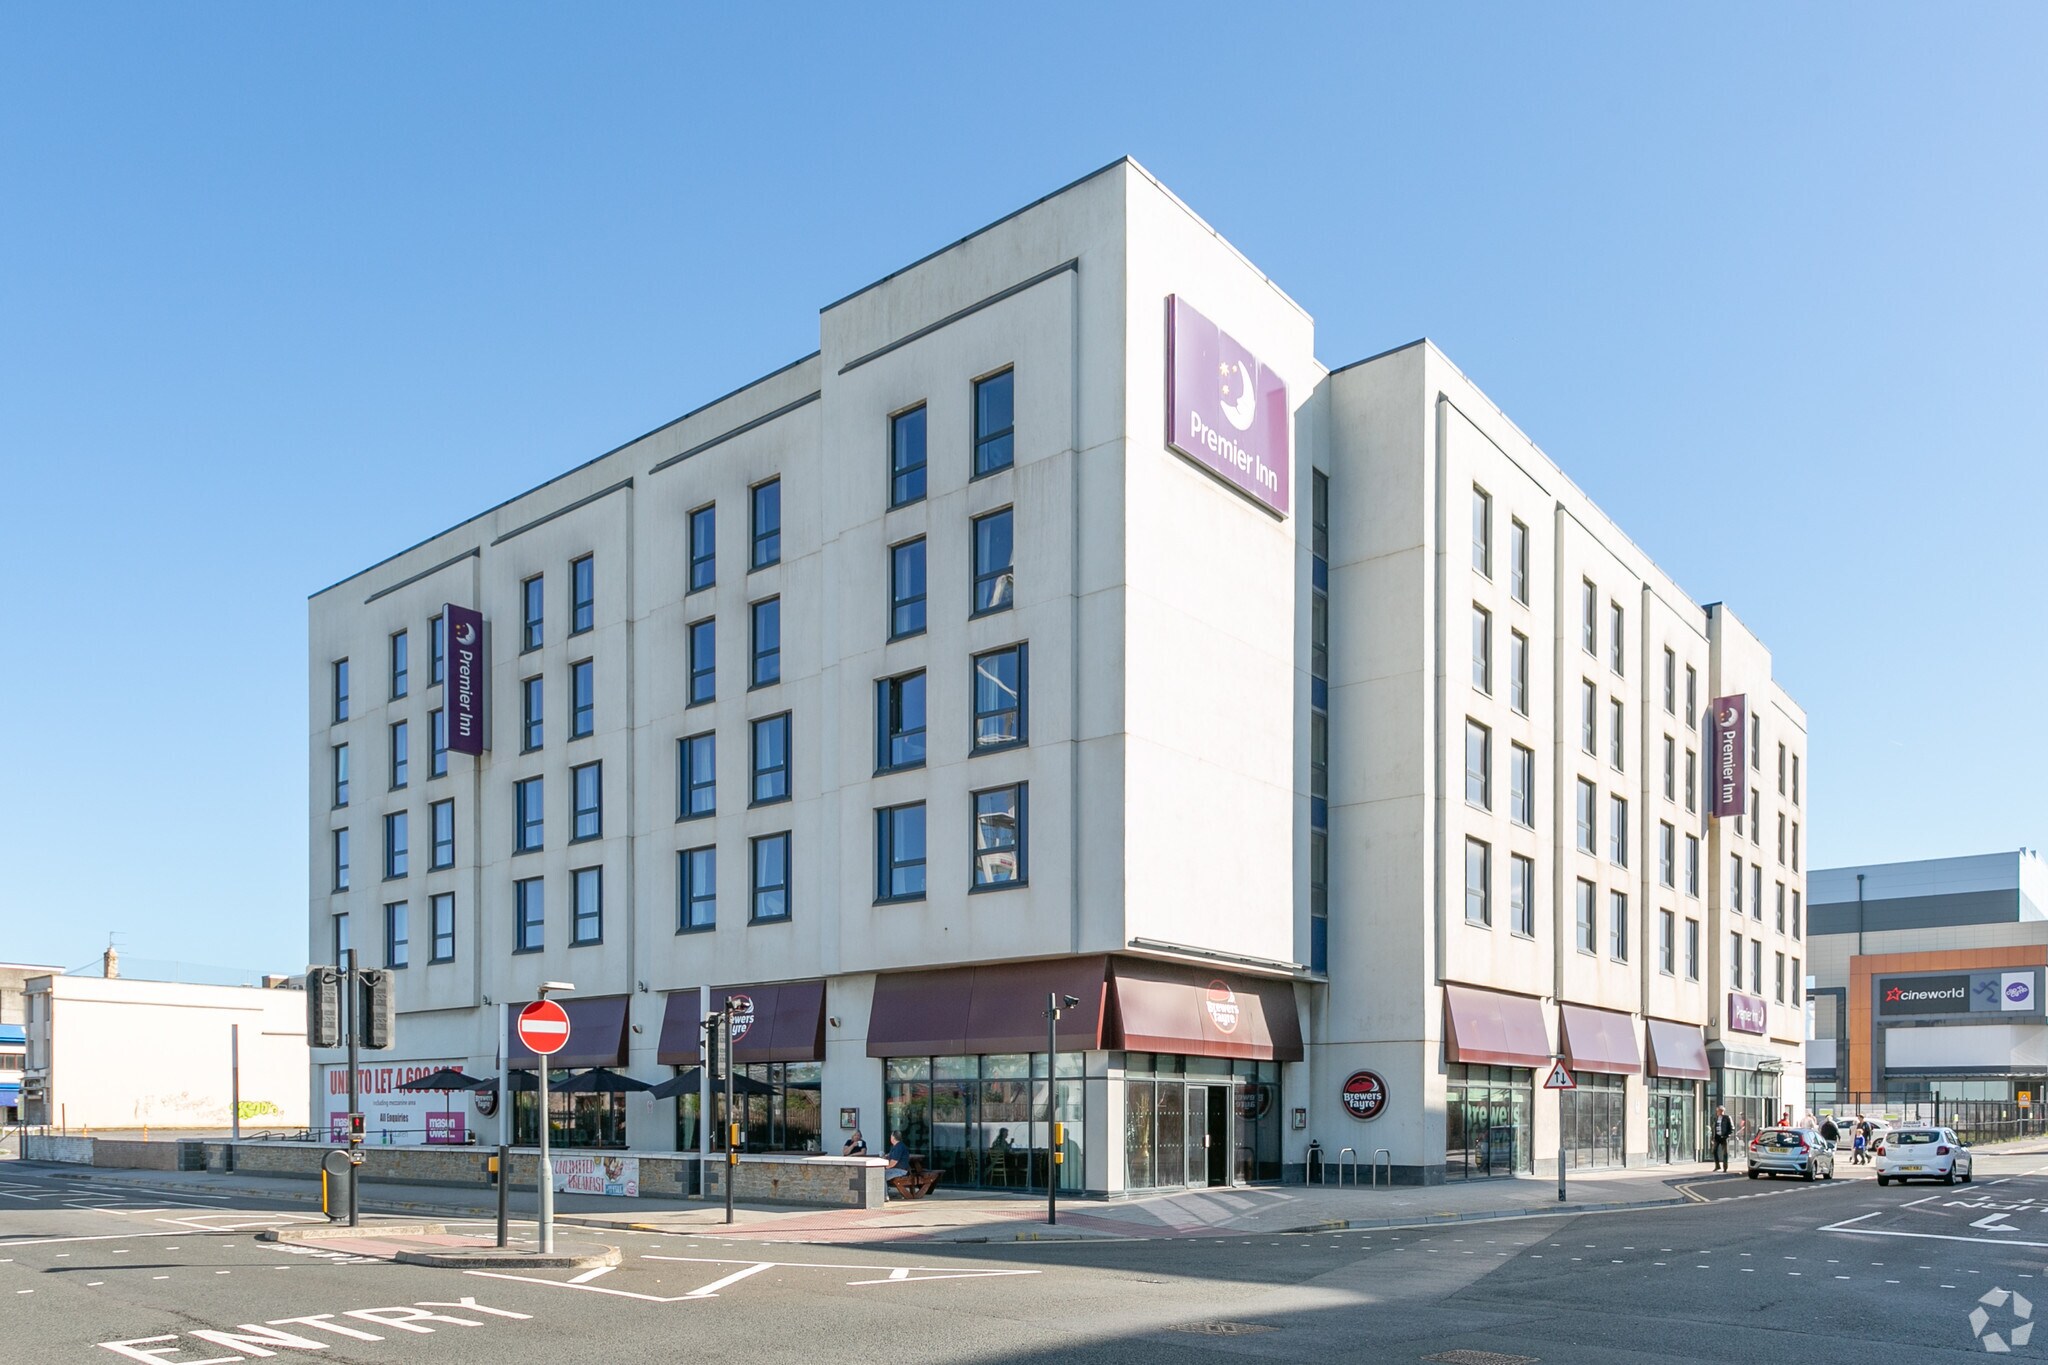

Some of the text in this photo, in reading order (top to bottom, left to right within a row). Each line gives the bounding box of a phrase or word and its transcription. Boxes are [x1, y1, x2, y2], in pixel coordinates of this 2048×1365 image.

[1190, 410, 1278, 493] Premier Inn
[459, 649, 474, 737] Premier Inn
[1723, 730, 1736, 803] Premier Inn
[1900, 987, 1965, 1001] cineworld
[1206, 1001, 1239, 1015] Brewers
[729, 1014, 755, 1024] ewers
[1212, 1010, 1236, 1026] fayre
[731, 1024, 747, 1036] yre
[330, 1070, 350, 1095] UNI
[357, 1068, 372, 1095] TO
[375, 1068, 393, 1094] LET
[1343, 1093, 1382, 1102] Brewers
[1349, 1099, 1375, 1110] fayre
[387, 1113, 409, 1124] Enquiries
[555, 1159, 595, 1174] UNLIMITED
[568, 1174, 604, 1193] BREAKFAST
[97, 1297, 534, 1365] ENTRY
